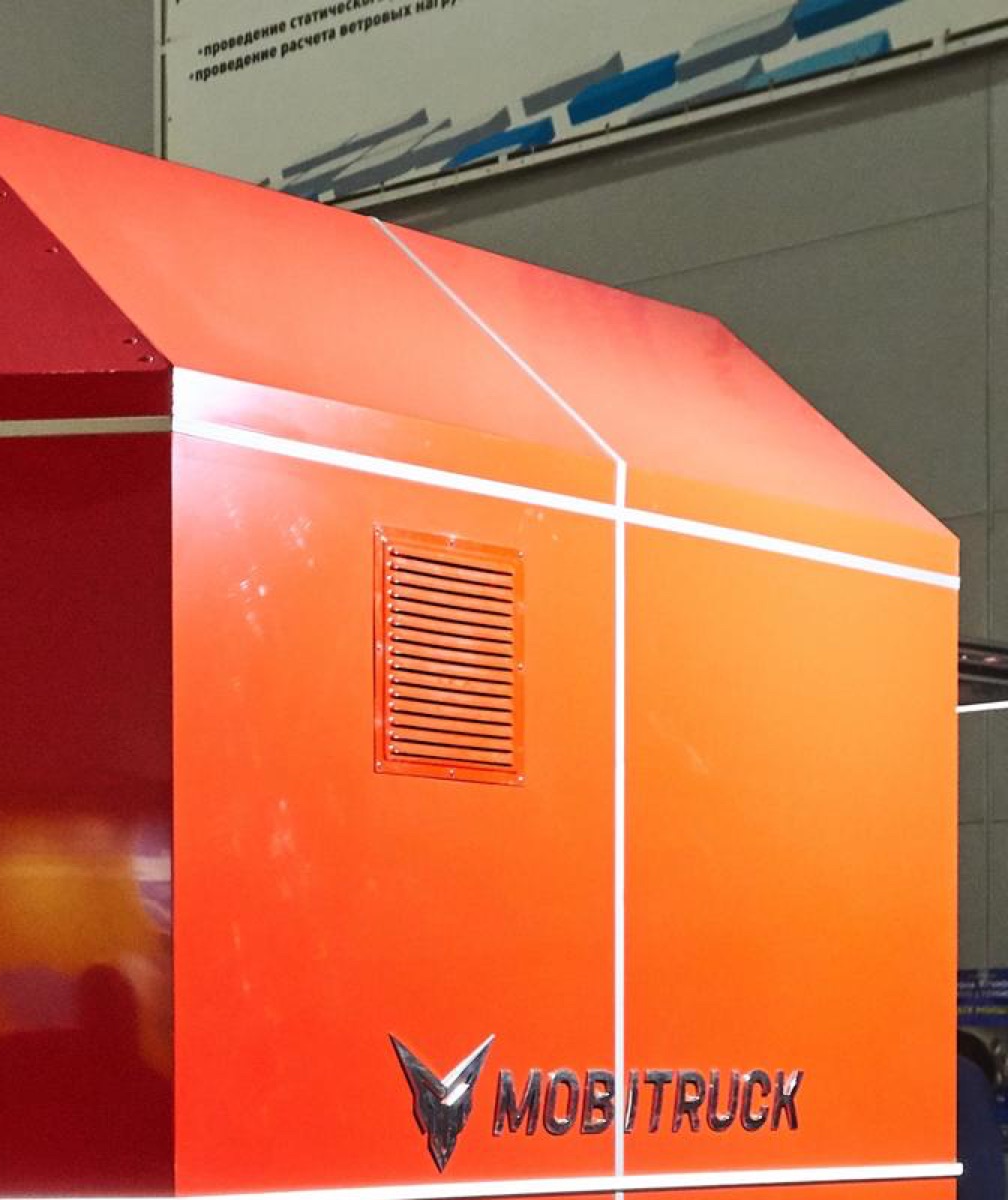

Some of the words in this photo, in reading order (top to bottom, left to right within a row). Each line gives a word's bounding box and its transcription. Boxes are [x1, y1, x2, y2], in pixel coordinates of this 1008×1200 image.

[281, 27, 336, 58] расчета
[339, 5, 412, 37] ветровых
[493, 1068, 804, 1136] MOBITRUCK
